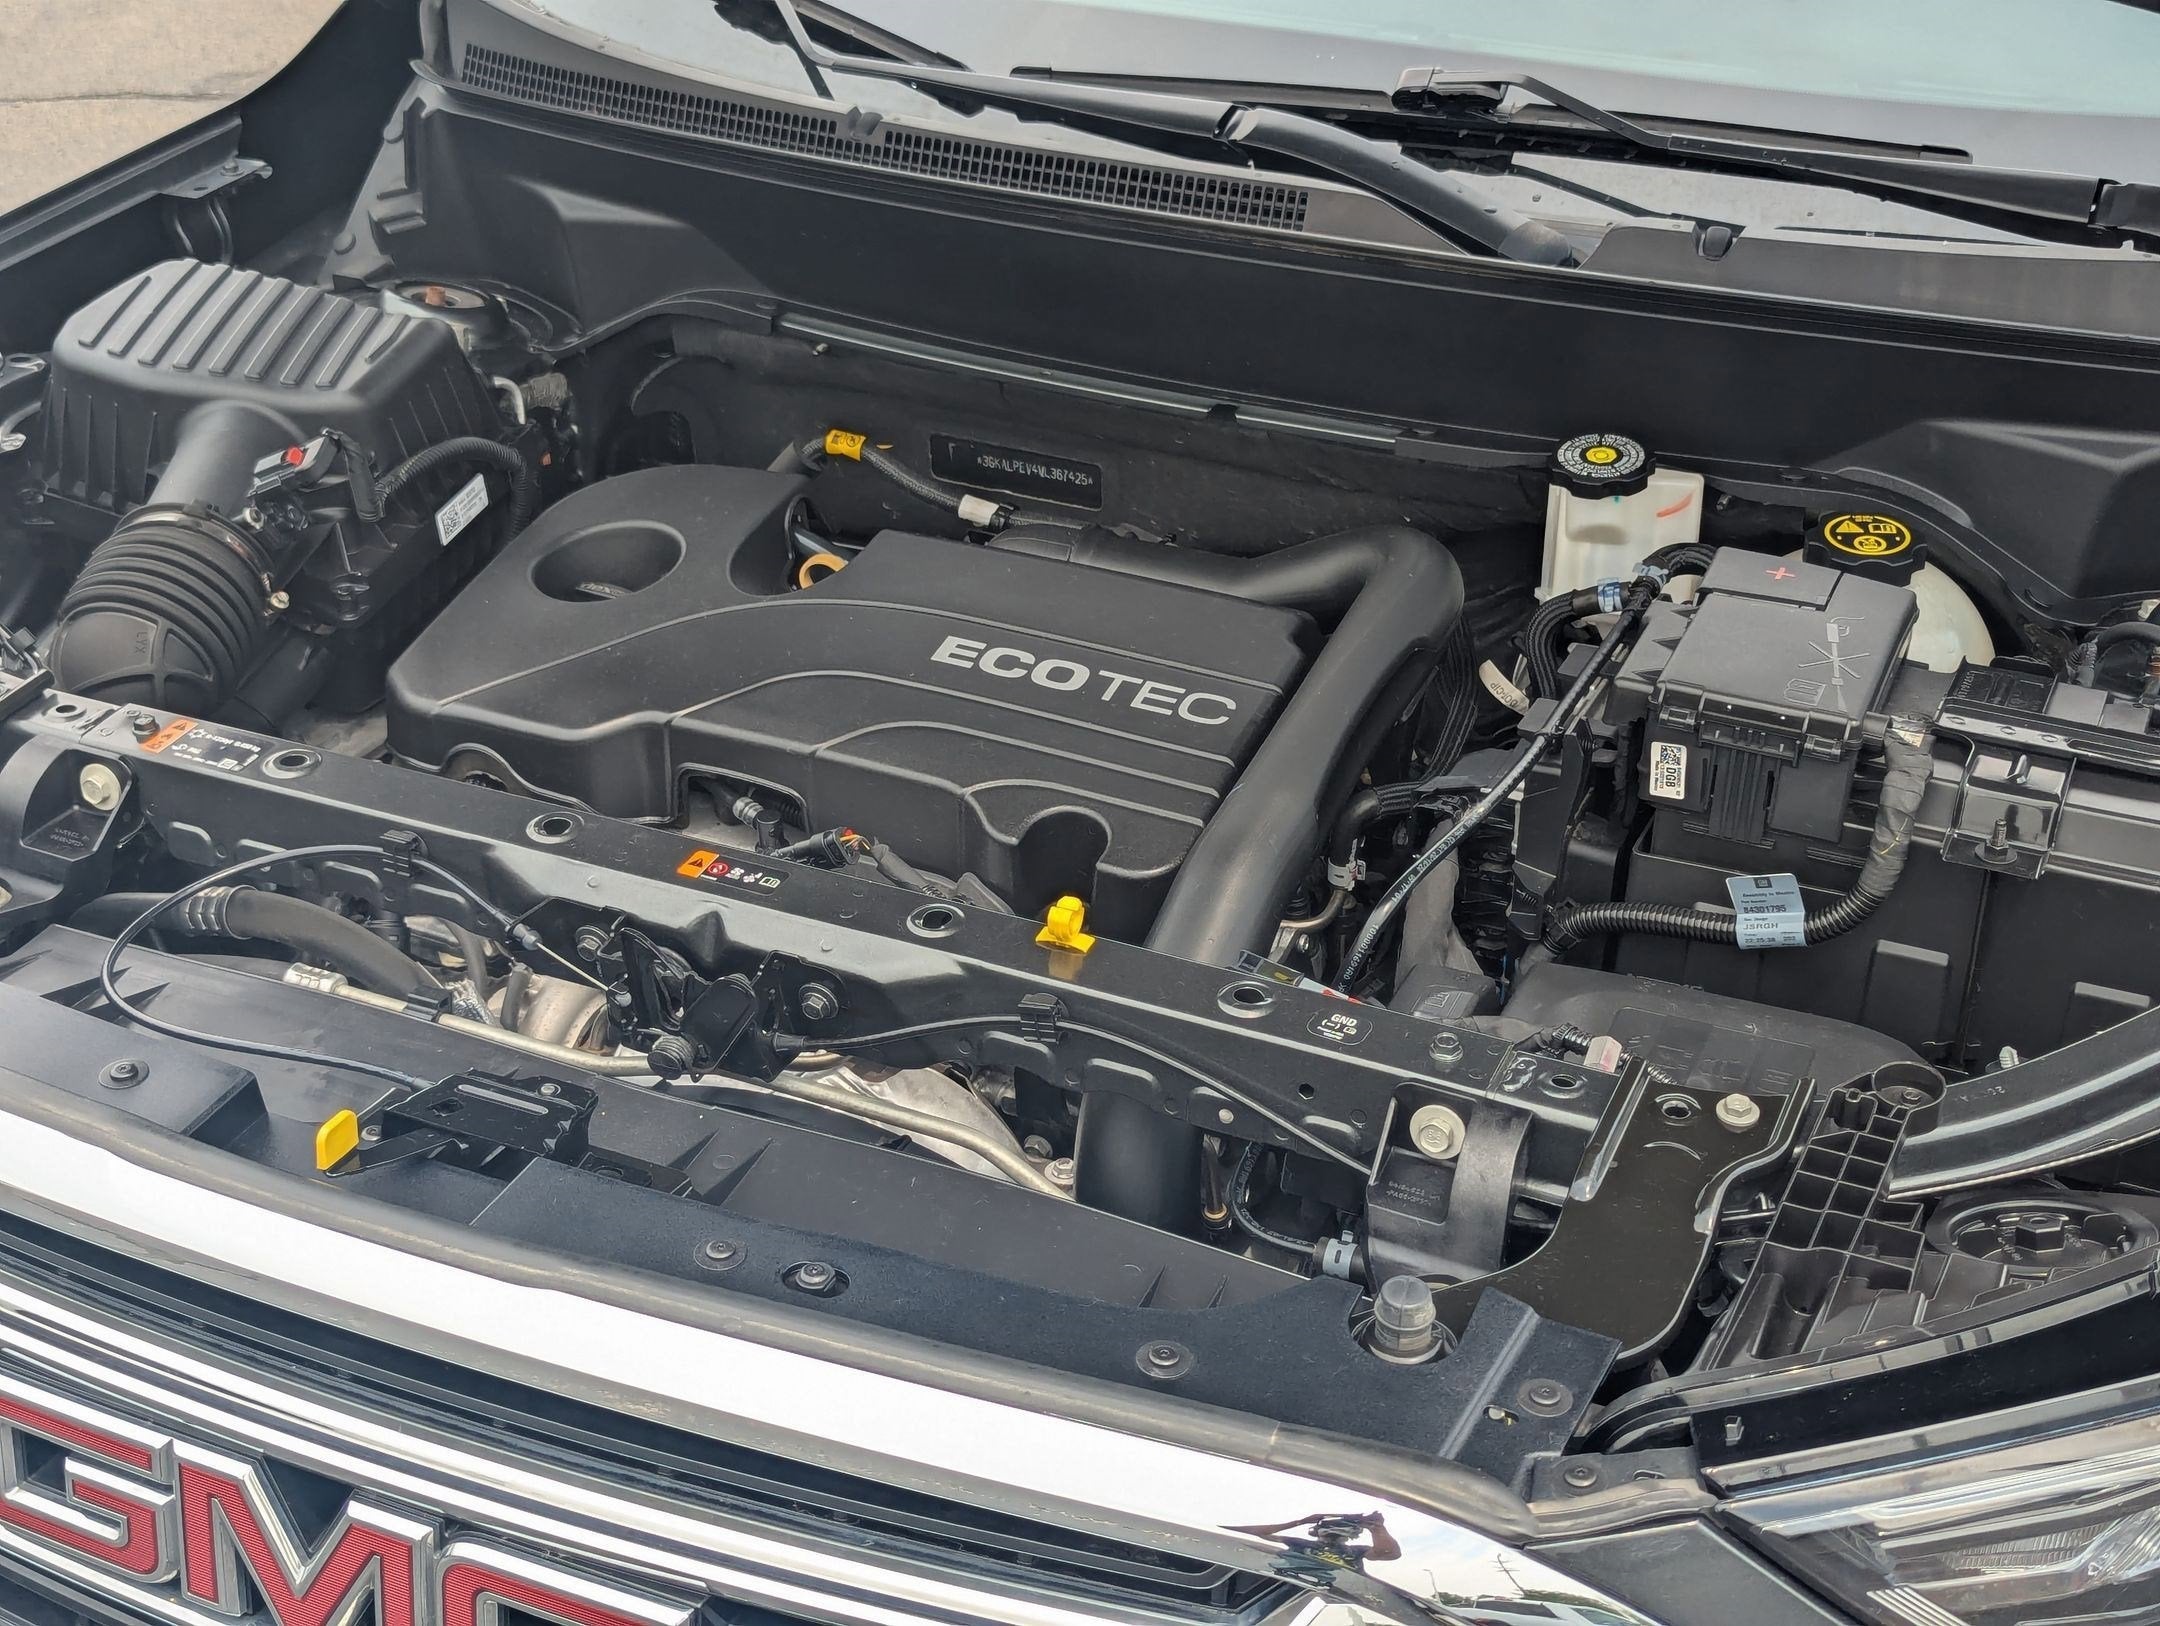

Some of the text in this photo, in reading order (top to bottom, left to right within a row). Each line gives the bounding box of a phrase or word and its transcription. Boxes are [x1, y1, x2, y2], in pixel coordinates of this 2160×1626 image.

[930, 635, 1237, 725] ECOTEC
[1665, 767, 1677, 788] DGB
[1331, 1013, 1358, 1027] GND
